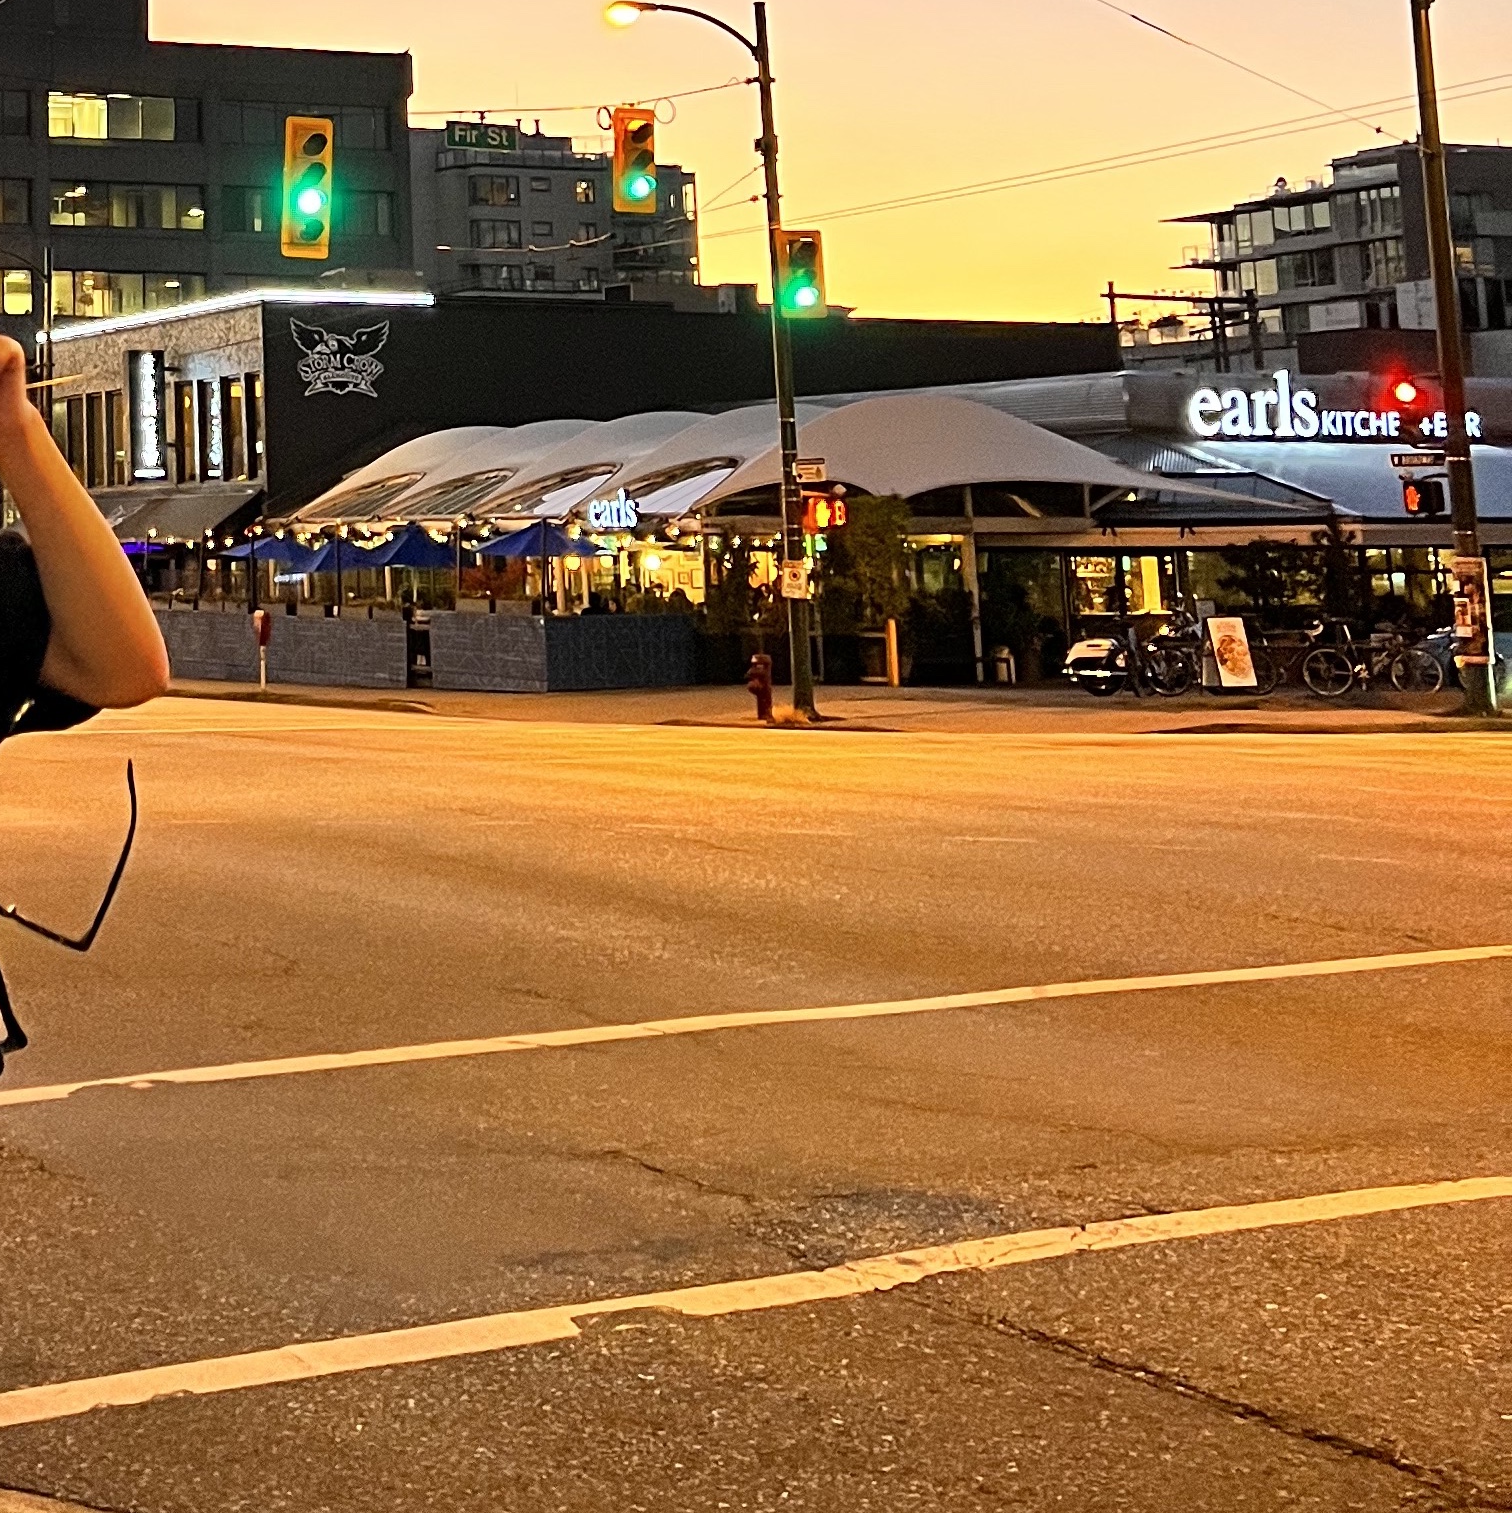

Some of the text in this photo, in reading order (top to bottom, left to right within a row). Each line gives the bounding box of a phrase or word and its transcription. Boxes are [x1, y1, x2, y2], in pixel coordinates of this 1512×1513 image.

[454, 125, 509, 145] Fir St
[300, 353, 342, 381] STORM
[1186, 368, 1320, 437] earls
[589, 487, 638, 528] earls
